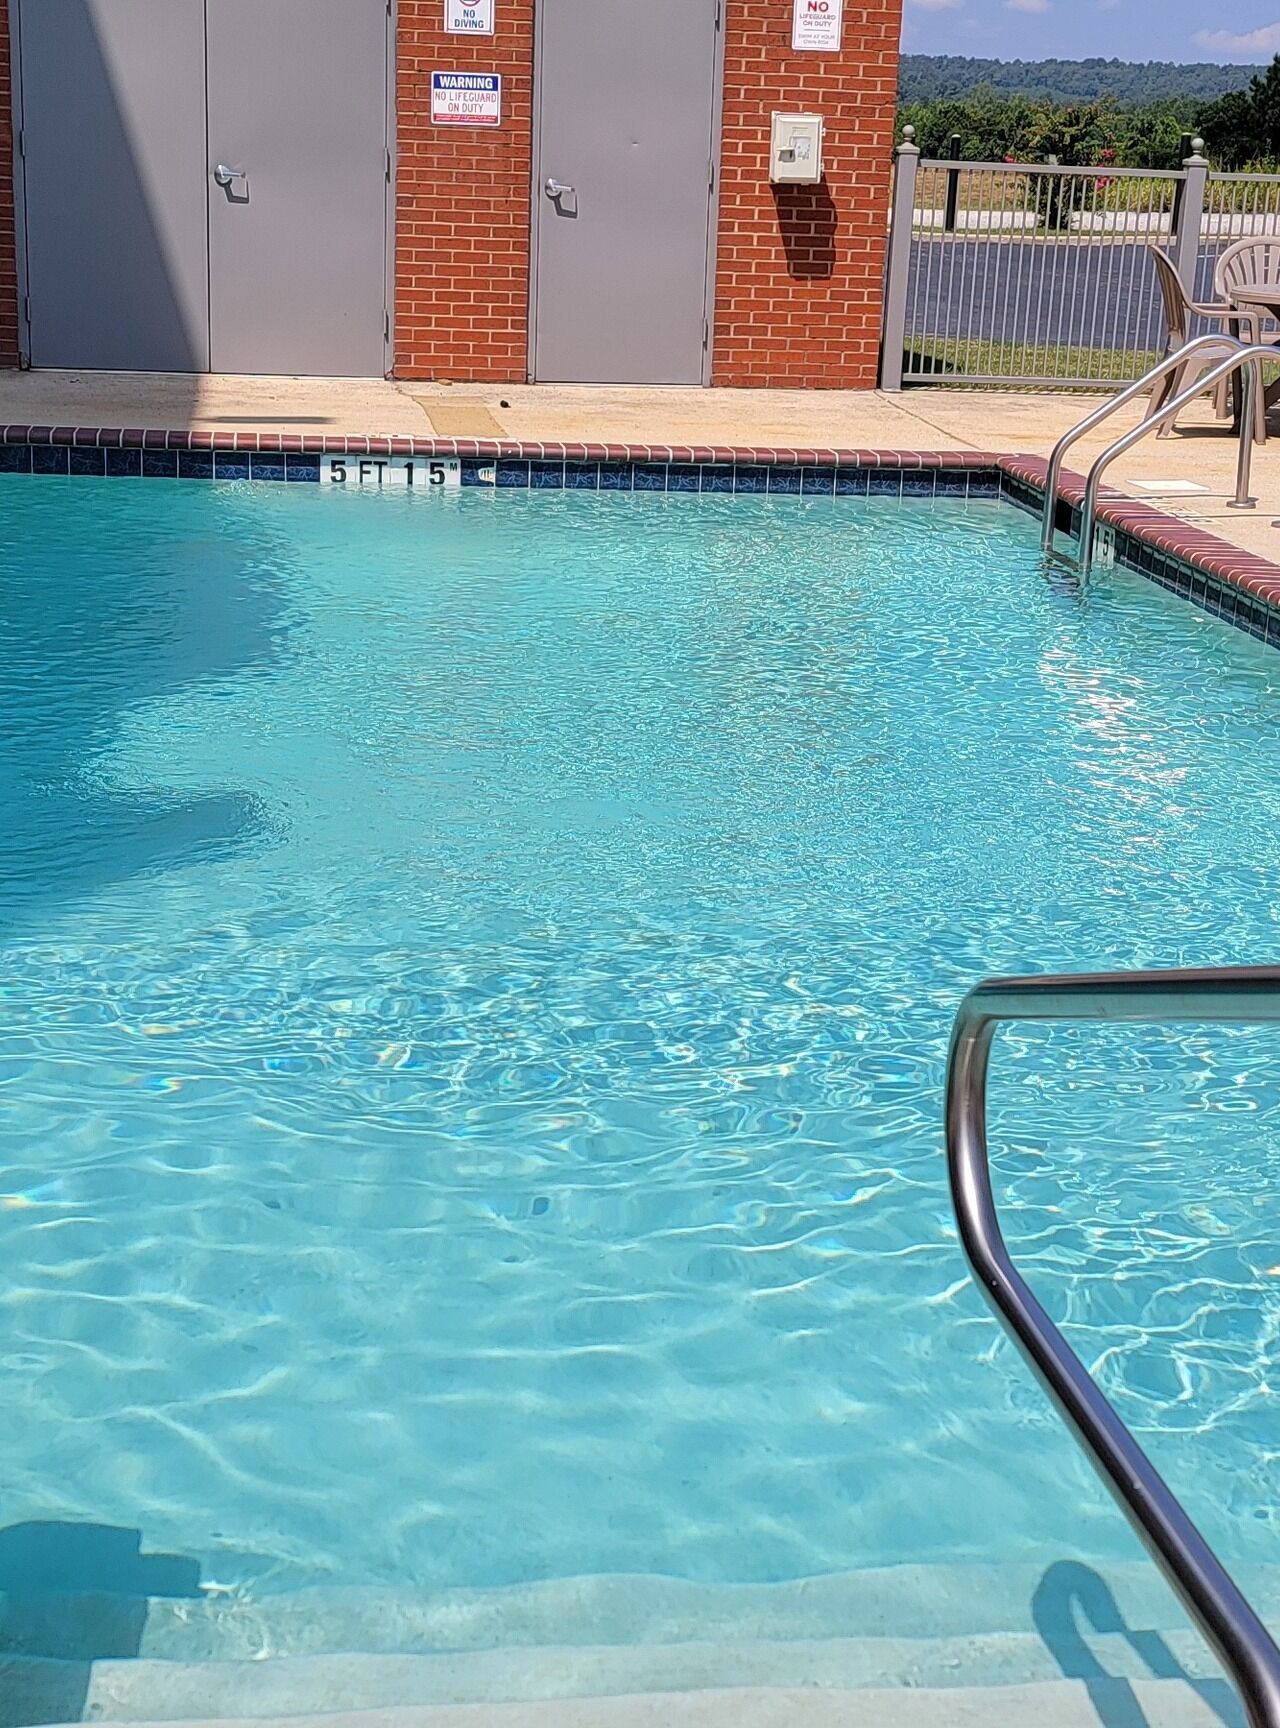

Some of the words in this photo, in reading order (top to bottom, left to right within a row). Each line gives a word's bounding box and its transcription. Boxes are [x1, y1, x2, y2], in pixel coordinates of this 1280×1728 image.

[807, 1, 829, 12] NO
[463, 9, 475, 18] NO
[454, 19, 484, 28] DIVING
[439, 76, 493, 89] WARNING
[435, 91, 446, 101] NO
[449, 92, 497, 103] LIFEGUARD
[448, 103, 459, 112] ON
[462, 103, 484, 113] DUTY
[330, 460, 347, 483] 5
[360, 461, 387, 484] FT
[450, 463, 458, 472] M
